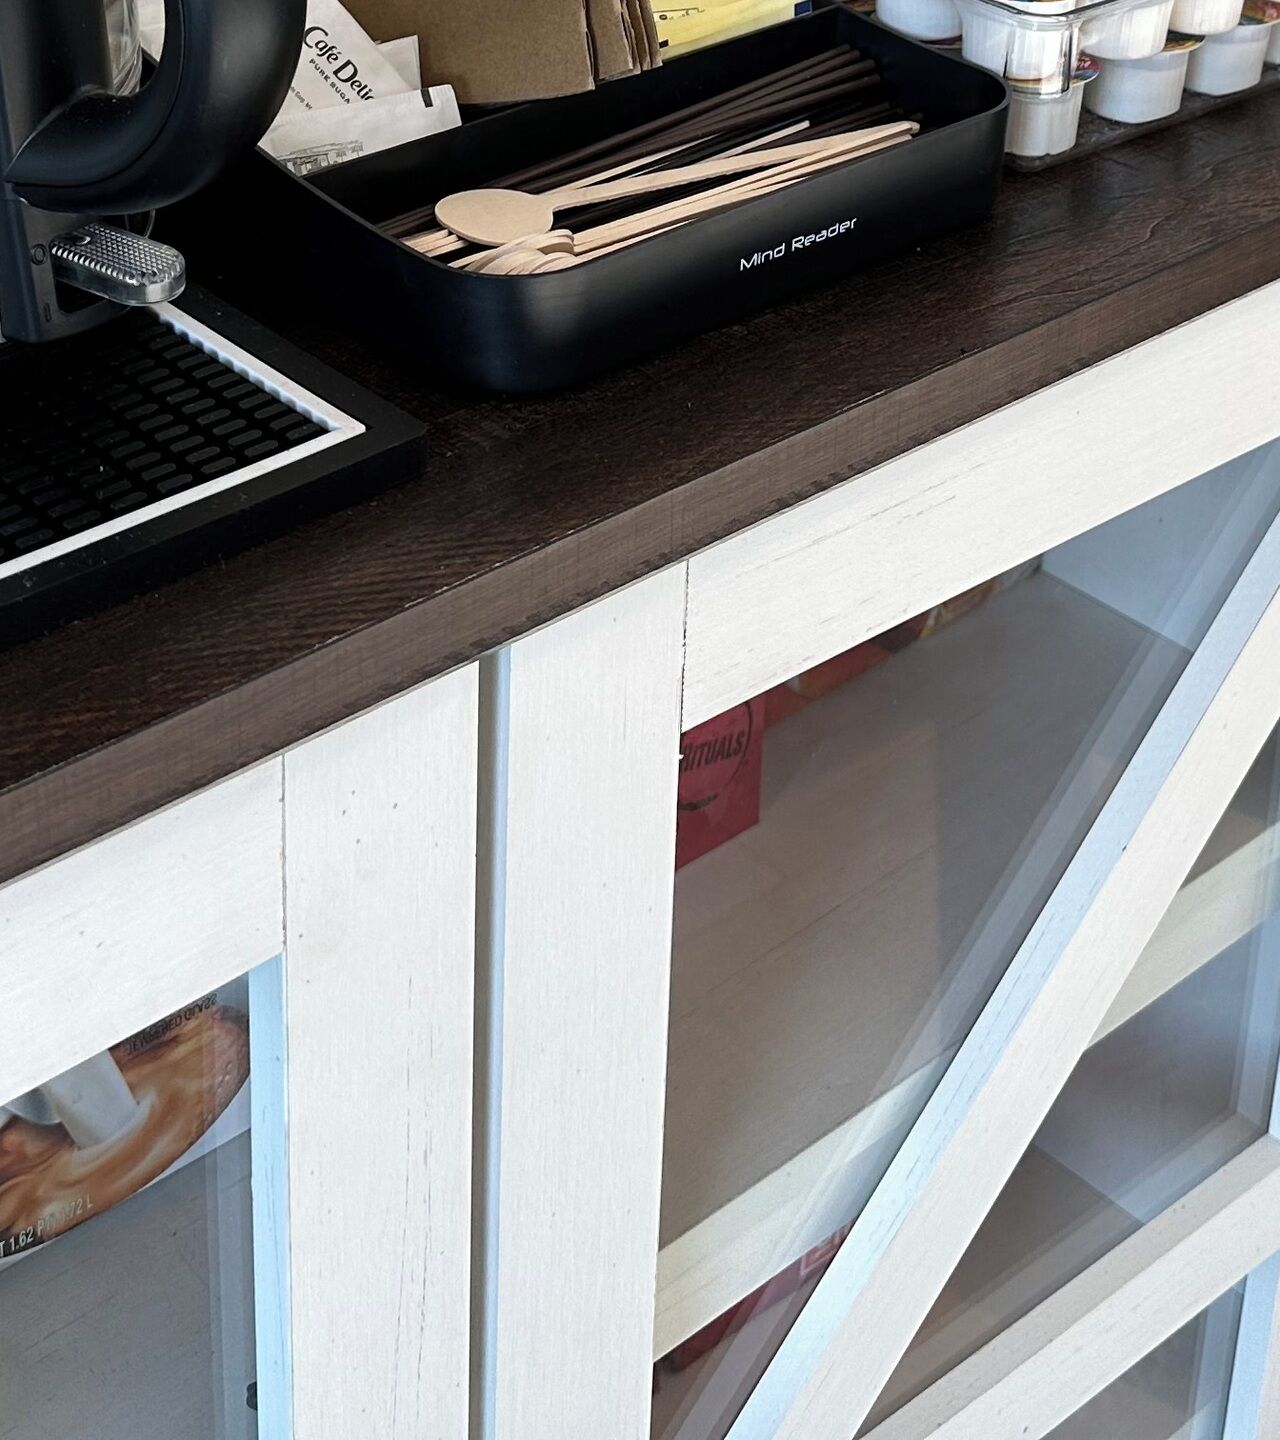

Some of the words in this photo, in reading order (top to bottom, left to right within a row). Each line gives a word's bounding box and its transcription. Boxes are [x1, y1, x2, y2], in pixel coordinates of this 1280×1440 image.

[304, 26, 342, 64] Café
[332, 60, 376, 102] Deli
[309, 58, 331, 83] PURE
[330, 81, 351, 105] SUGA
[740, 243, 786, 271] Mind
[791, 217, 858, 252] Reader
[9, 1225, 35, 1251] 1.62
